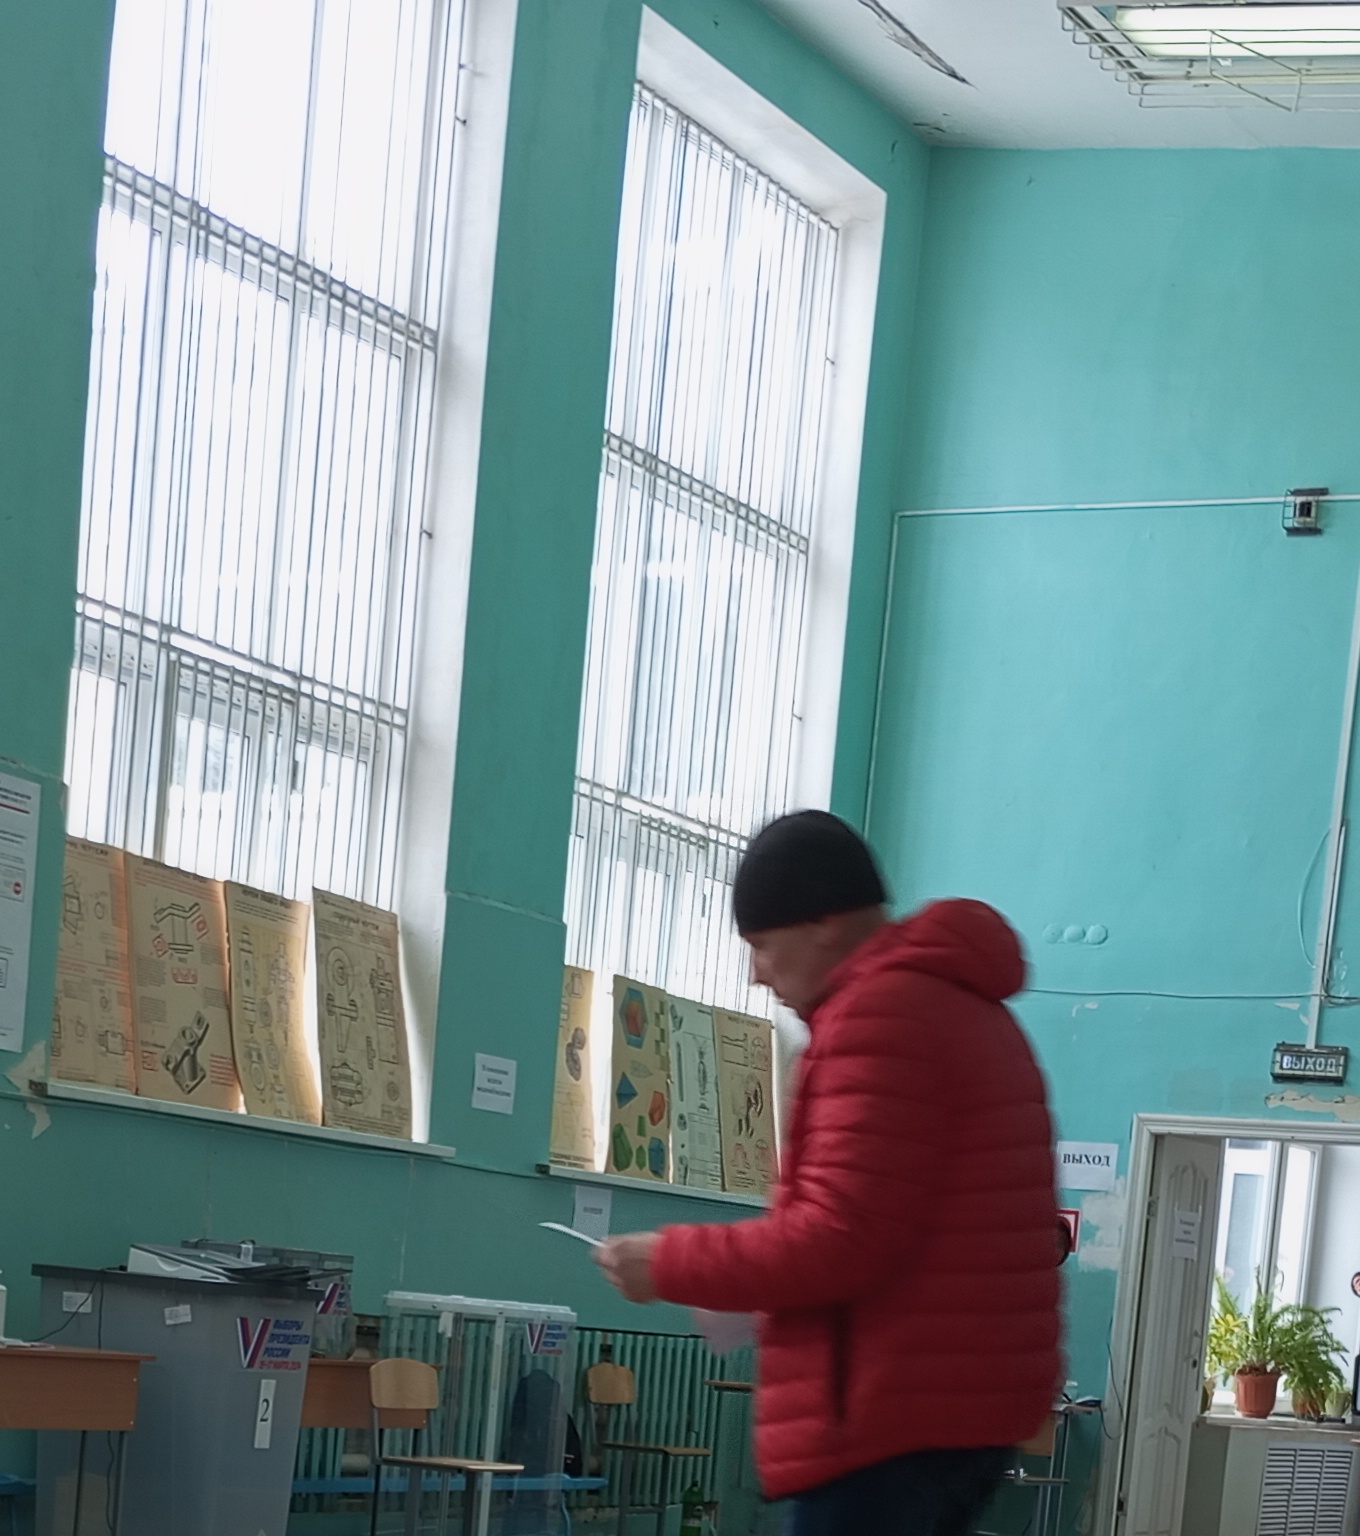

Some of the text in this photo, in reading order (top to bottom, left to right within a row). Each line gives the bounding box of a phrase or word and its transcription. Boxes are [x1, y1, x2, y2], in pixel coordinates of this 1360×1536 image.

[1282, 1055, 1337, 1072] ВЫХОД
[1063, 1153, 1110, 1167] ВЫХОД
[273, 1319, 304, 1331] ВЫБОРЫ
[268, 1333, 311, 1345] ПРЕЗИДЕНТА
[262, 1347, 292, 1358] РОССИИ
[259, 1398, 271, 1423] 2
